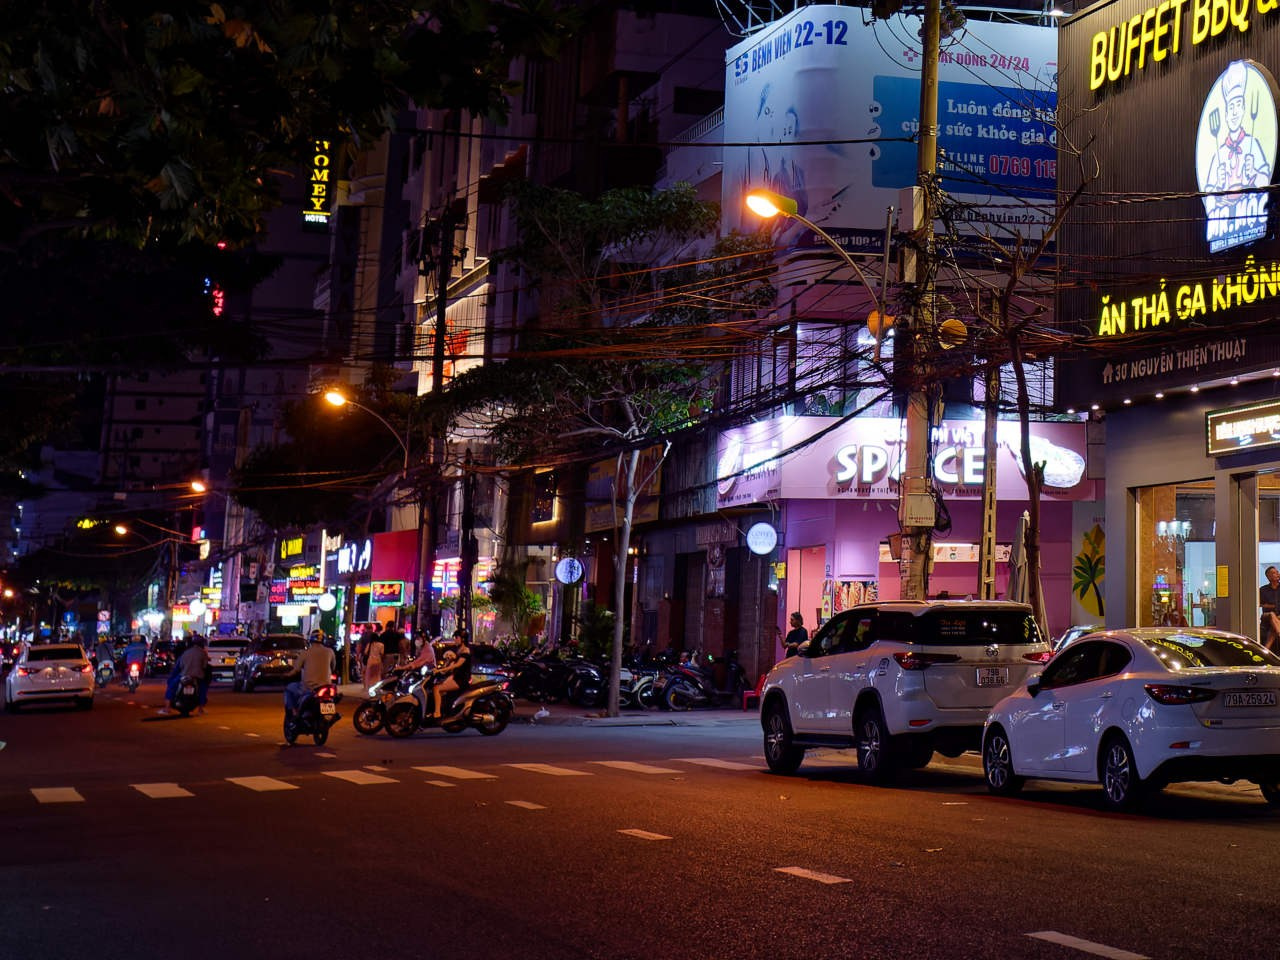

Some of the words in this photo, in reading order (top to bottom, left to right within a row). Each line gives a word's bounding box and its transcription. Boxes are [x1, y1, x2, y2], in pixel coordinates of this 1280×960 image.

[752, 46, 772, 73] BỆNH
[774, 28, 792, 60] VIỆN
[794, 20, 848, 46] 22-12
[990, 53, 1030, 72] 24/24
[947, 99, 988, 116] Luôn
[992, 101, 1033, 123] đồng
[945, 122, 973, 137] sức
[977, 123, 1017, 140] khỏe
[1021, 130, 1044, 145] gia
[940, 152, 985, 164] TLINE
[989, 155, 1031, 177] 0769
[1099, 295, 1126, 335] ĂN
[1132, 278, 1170, 330] THẢ
[1176, 284, 1206, 320] GA
[1115, 362, 1128, 382] 30
[1177, 344, 1207, 371] THIỆN
[1210, 338, 1247, 362] THUẬT
